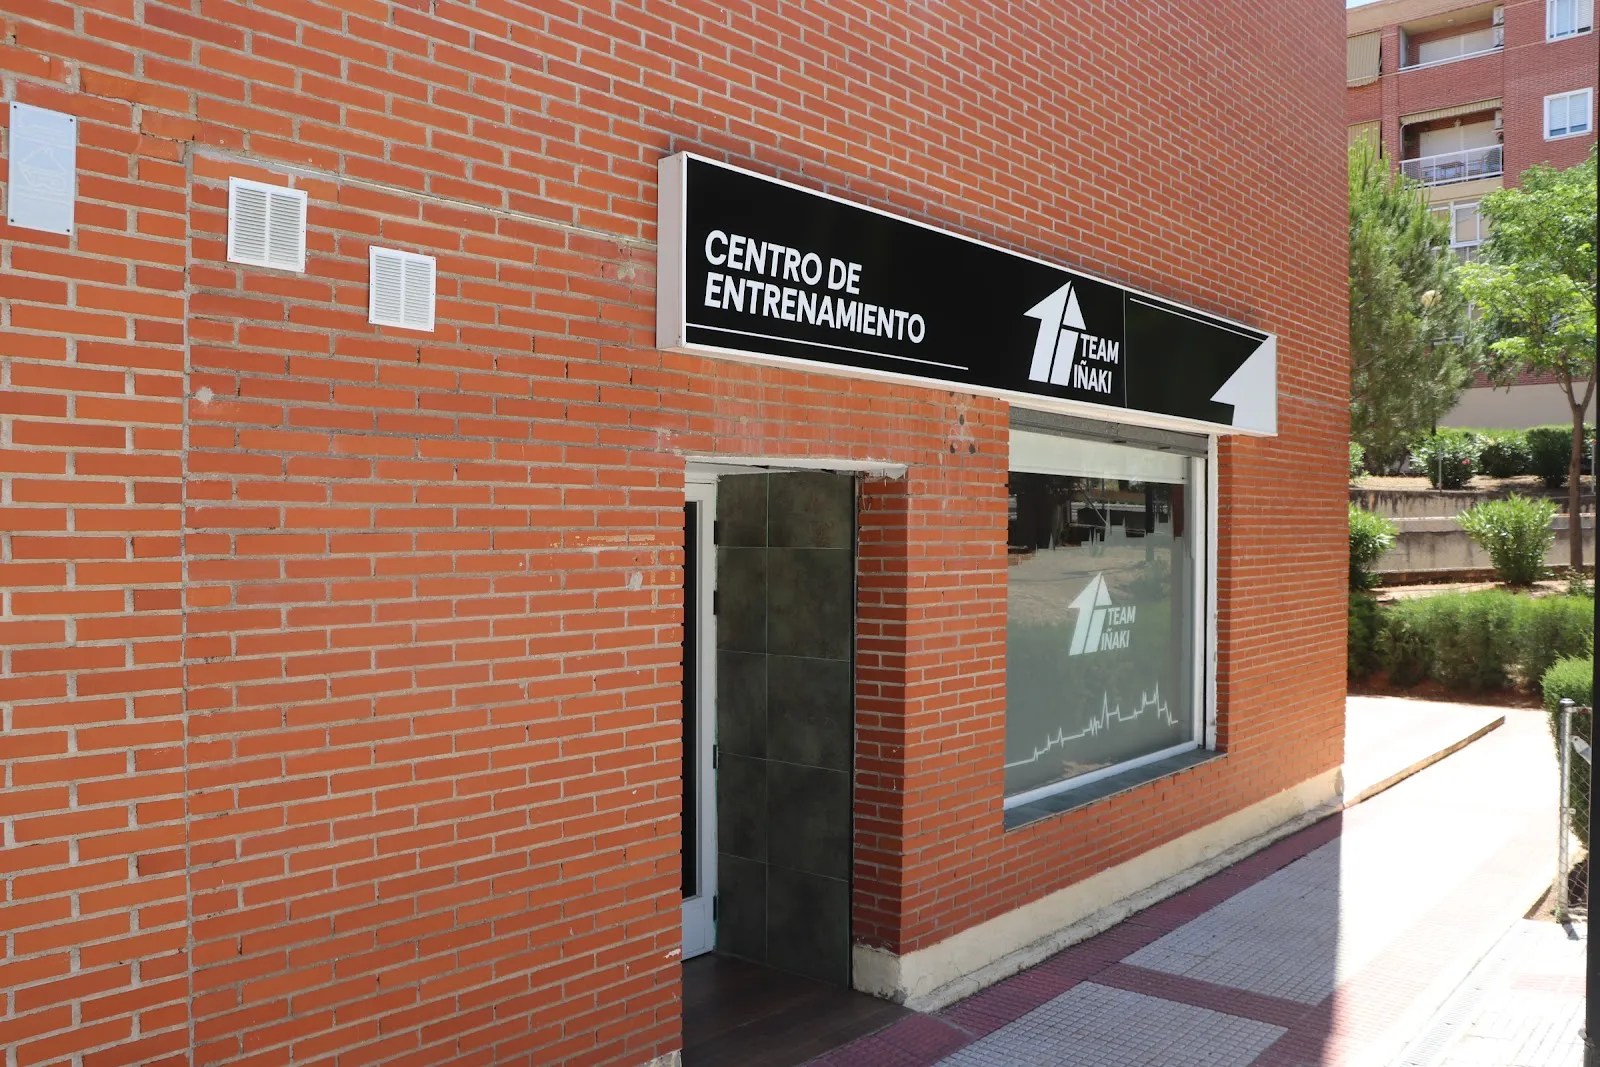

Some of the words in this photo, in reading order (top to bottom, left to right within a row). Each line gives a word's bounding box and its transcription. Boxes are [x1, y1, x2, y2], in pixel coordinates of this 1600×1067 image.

[705, 230, 822, 286] CENTRO
[827, 258, 862, 295] DE
[704, 272, 926, 344] ENTRENAMIENTO
[1080, 333, 1119, 364] TEAM
[1073, 360, 1112, 394] IÑAKI
[1107, 606, 1135, 625] TEAM
[1101, 628, 1129, 651] IÑAKI
